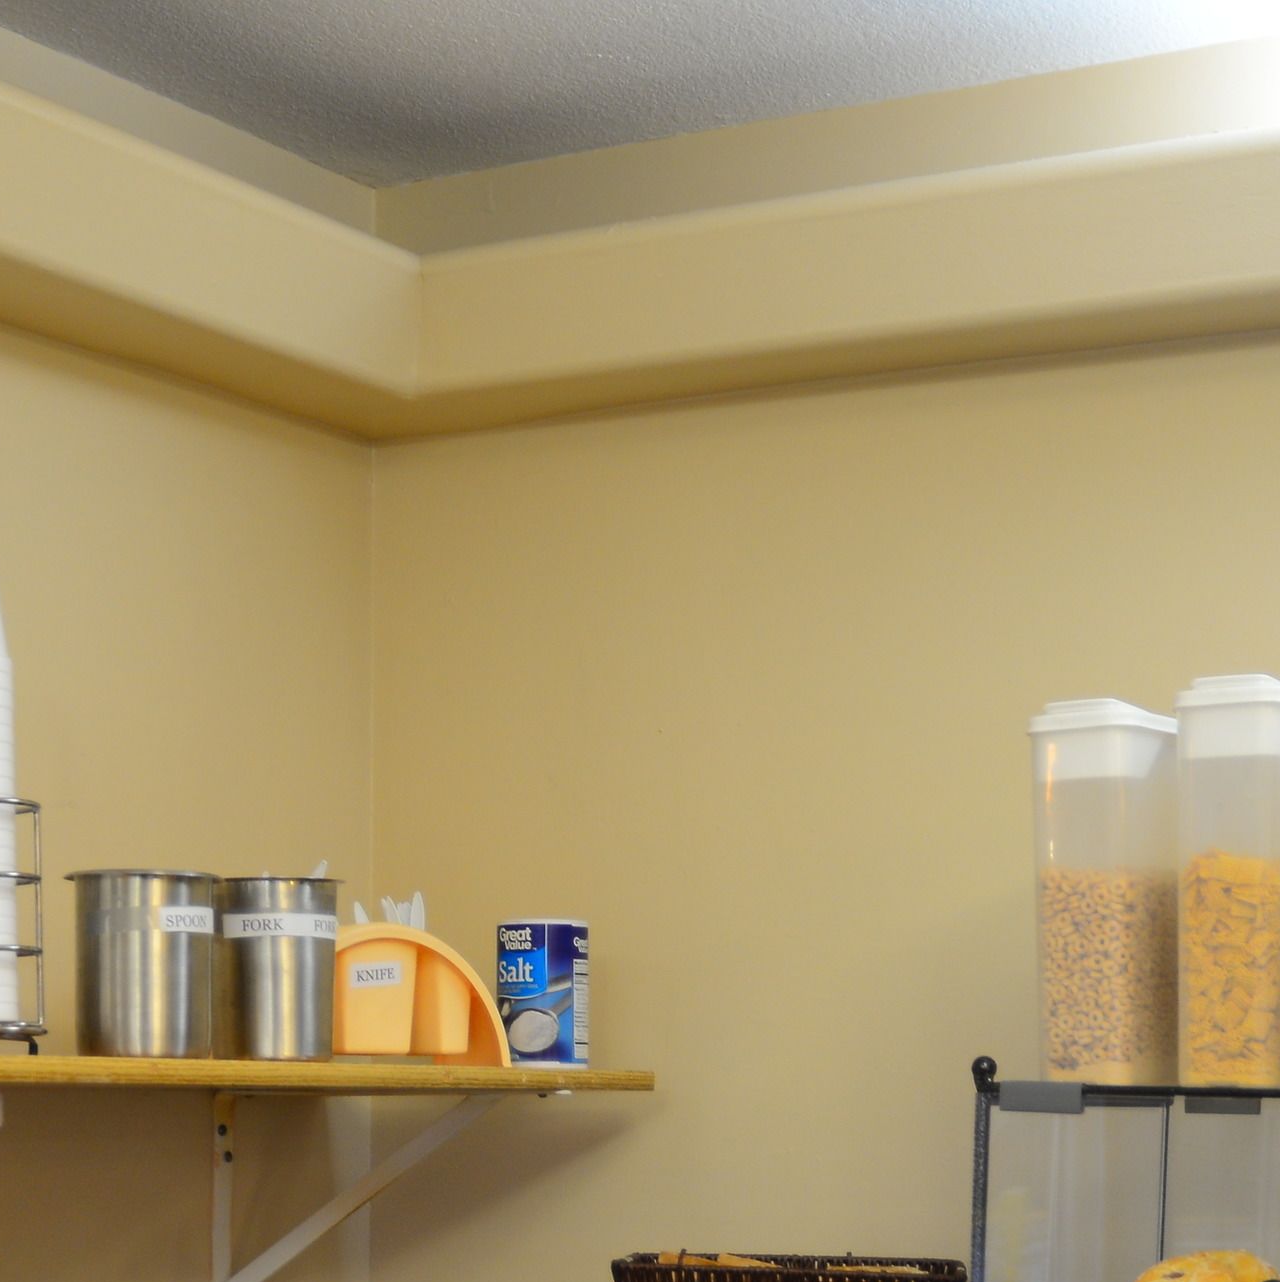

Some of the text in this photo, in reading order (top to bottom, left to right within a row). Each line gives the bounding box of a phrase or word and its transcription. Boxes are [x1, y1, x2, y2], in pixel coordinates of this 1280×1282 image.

[166, 914, 208, 928] SPOON
[243, 918, 284, 932] FORK
[500, 927, 532, 942] Great
[504, 940, 532, 951] Value
[356, 967, 395, 981] KNIFE
[499, 957, 534, 983] Salt
